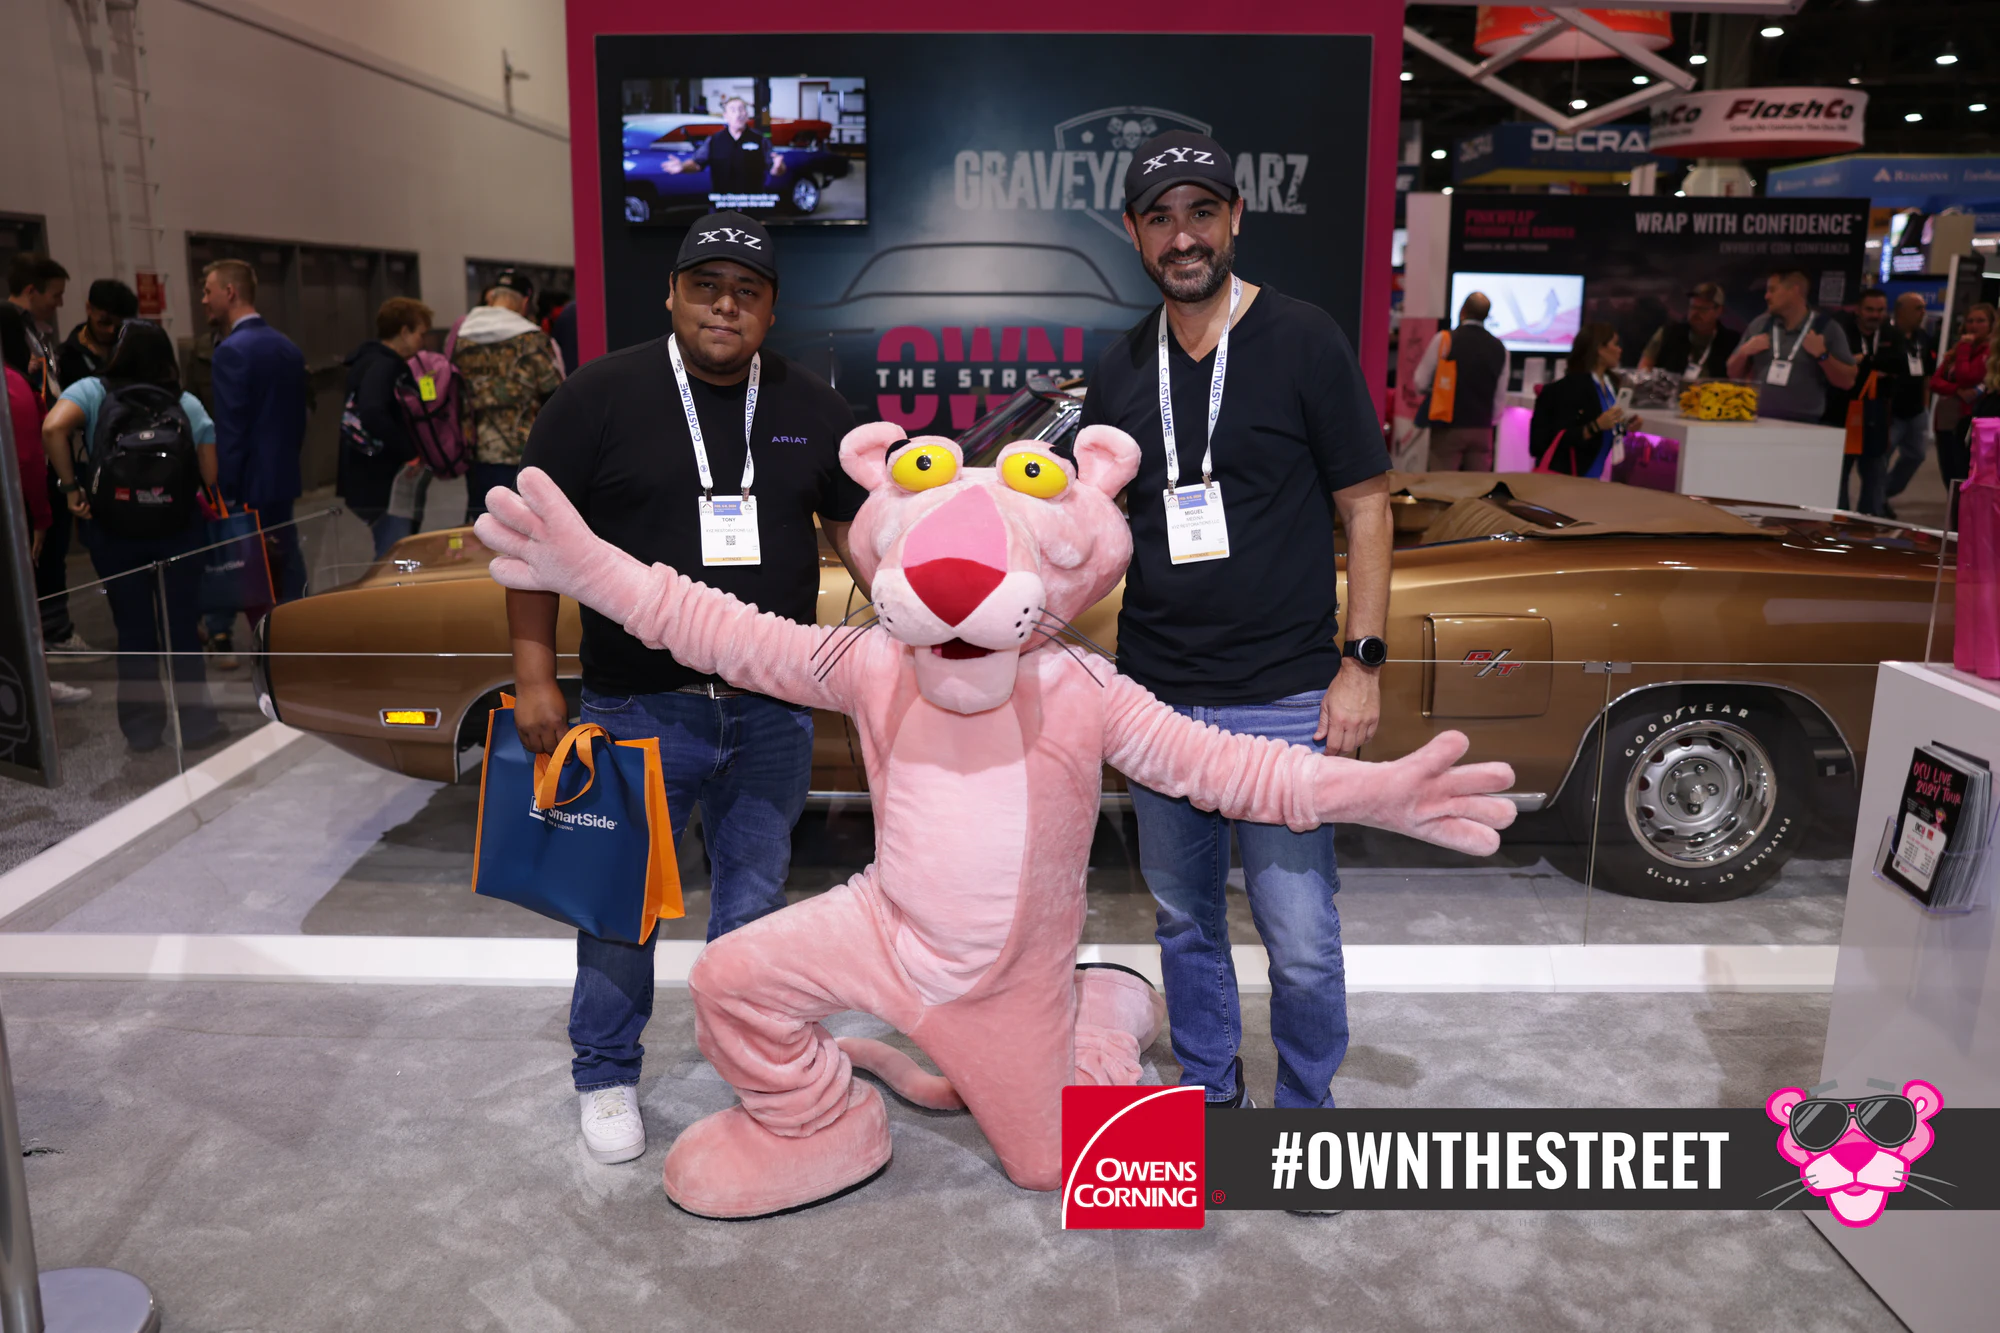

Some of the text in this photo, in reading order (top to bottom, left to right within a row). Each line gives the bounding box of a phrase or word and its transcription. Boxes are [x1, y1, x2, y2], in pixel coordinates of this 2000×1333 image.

[1724, 99, 1854, 120] FlashCo
[1531, 129, 1647, 152] DECRA
[1142, 147, 1215, 175] XYZ
[953, 150, 1309, 214] GRAVEYA ARZ
[1635, 212, 1853, 234] WRAP WITH CONFIDENCE
[697, 228, 762, 250] XYZ
[876, 369, 936, 388] THE
[771, 435, 808, 445] ARIAT
[1625, 703, 1749, 757] GOODYEAR
[1933, 769, 1953, 786] LIVE
[1916, 780, 1941, 801] 2024
